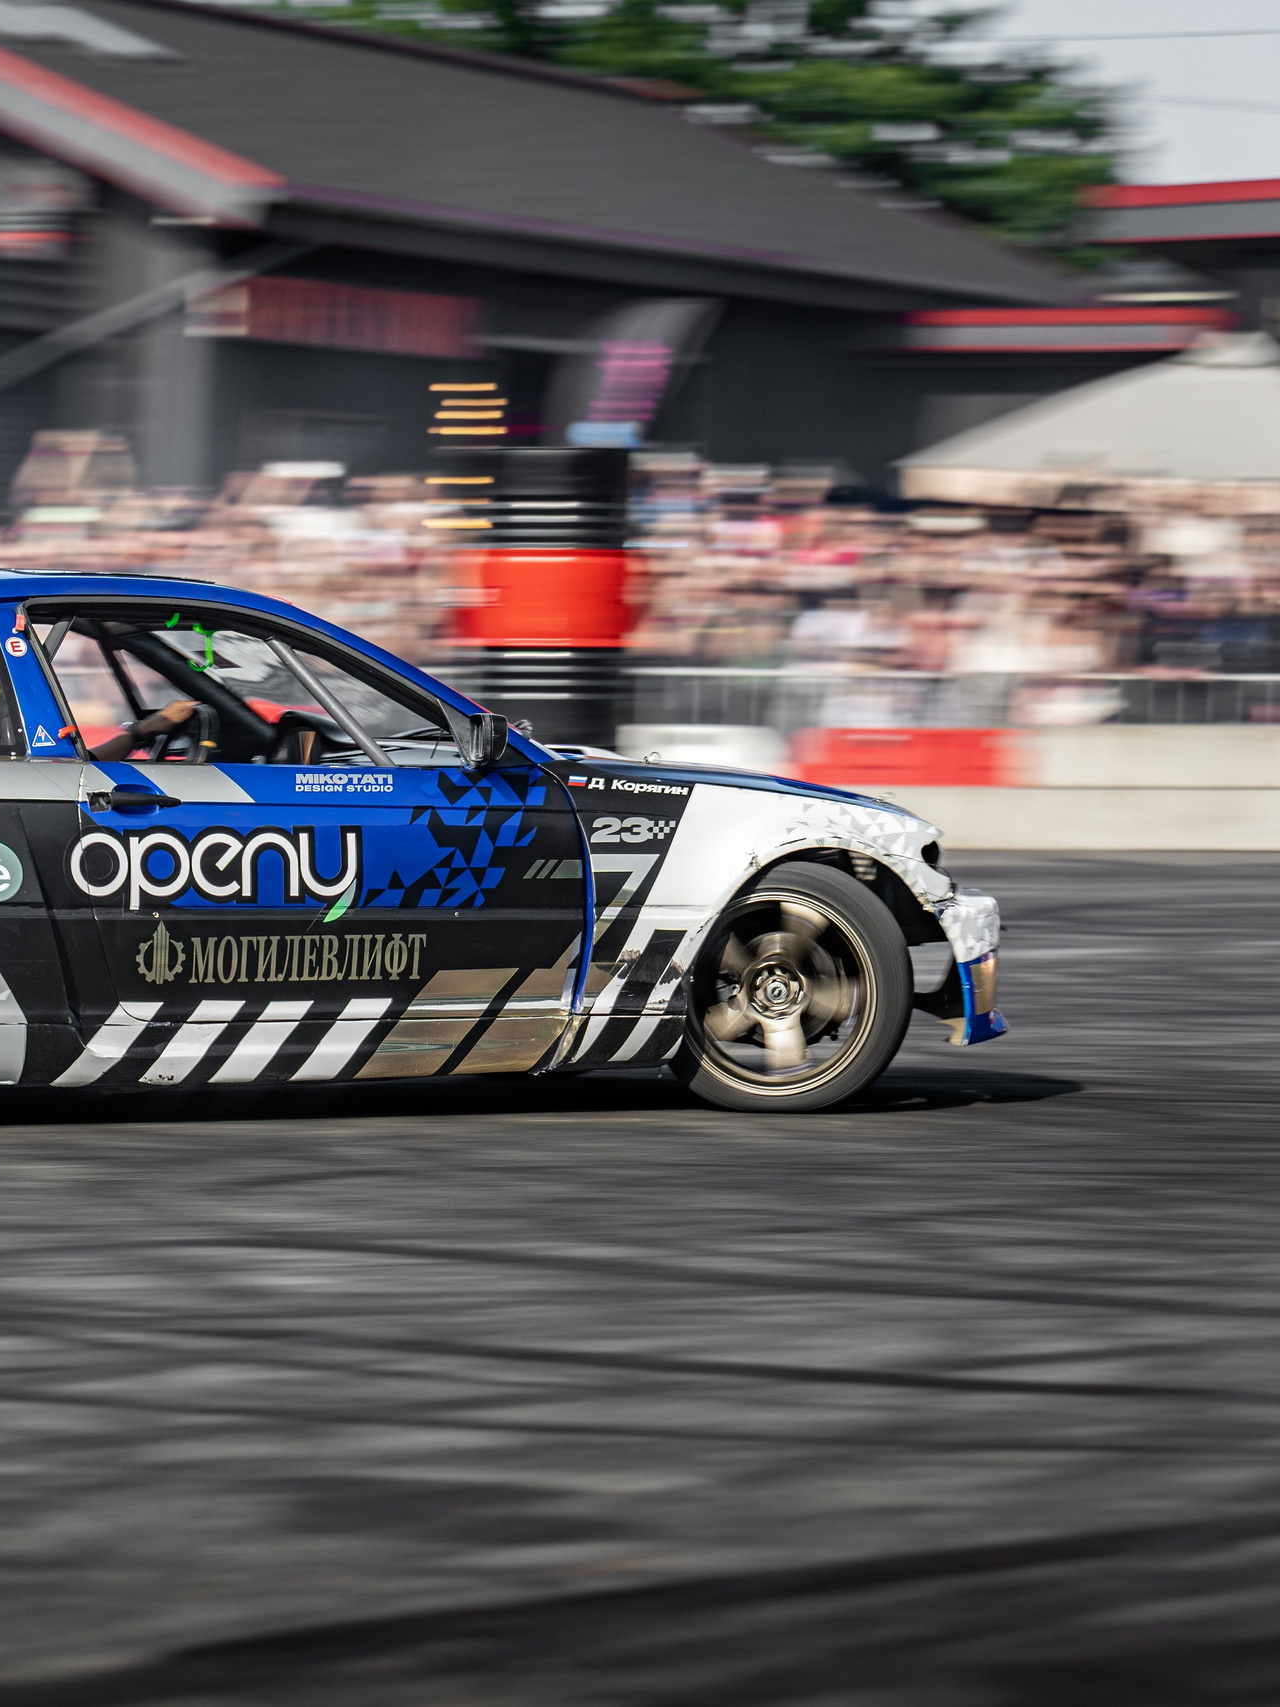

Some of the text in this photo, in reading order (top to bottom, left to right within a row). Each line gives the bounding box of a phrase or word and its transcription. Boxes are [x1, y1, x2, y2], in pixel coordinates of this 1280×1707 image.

[295, 773, 394, 785] MIKOTATI
[295, 784, 394, 792] DESIGN STUDIO
[612, 779, 689, 795] Корягин
[590, 816, 653, 843] 23
[70, 832, 357, 923] openy
[188, 933, 427, 984] МОГИЛЕВЛИФТ
